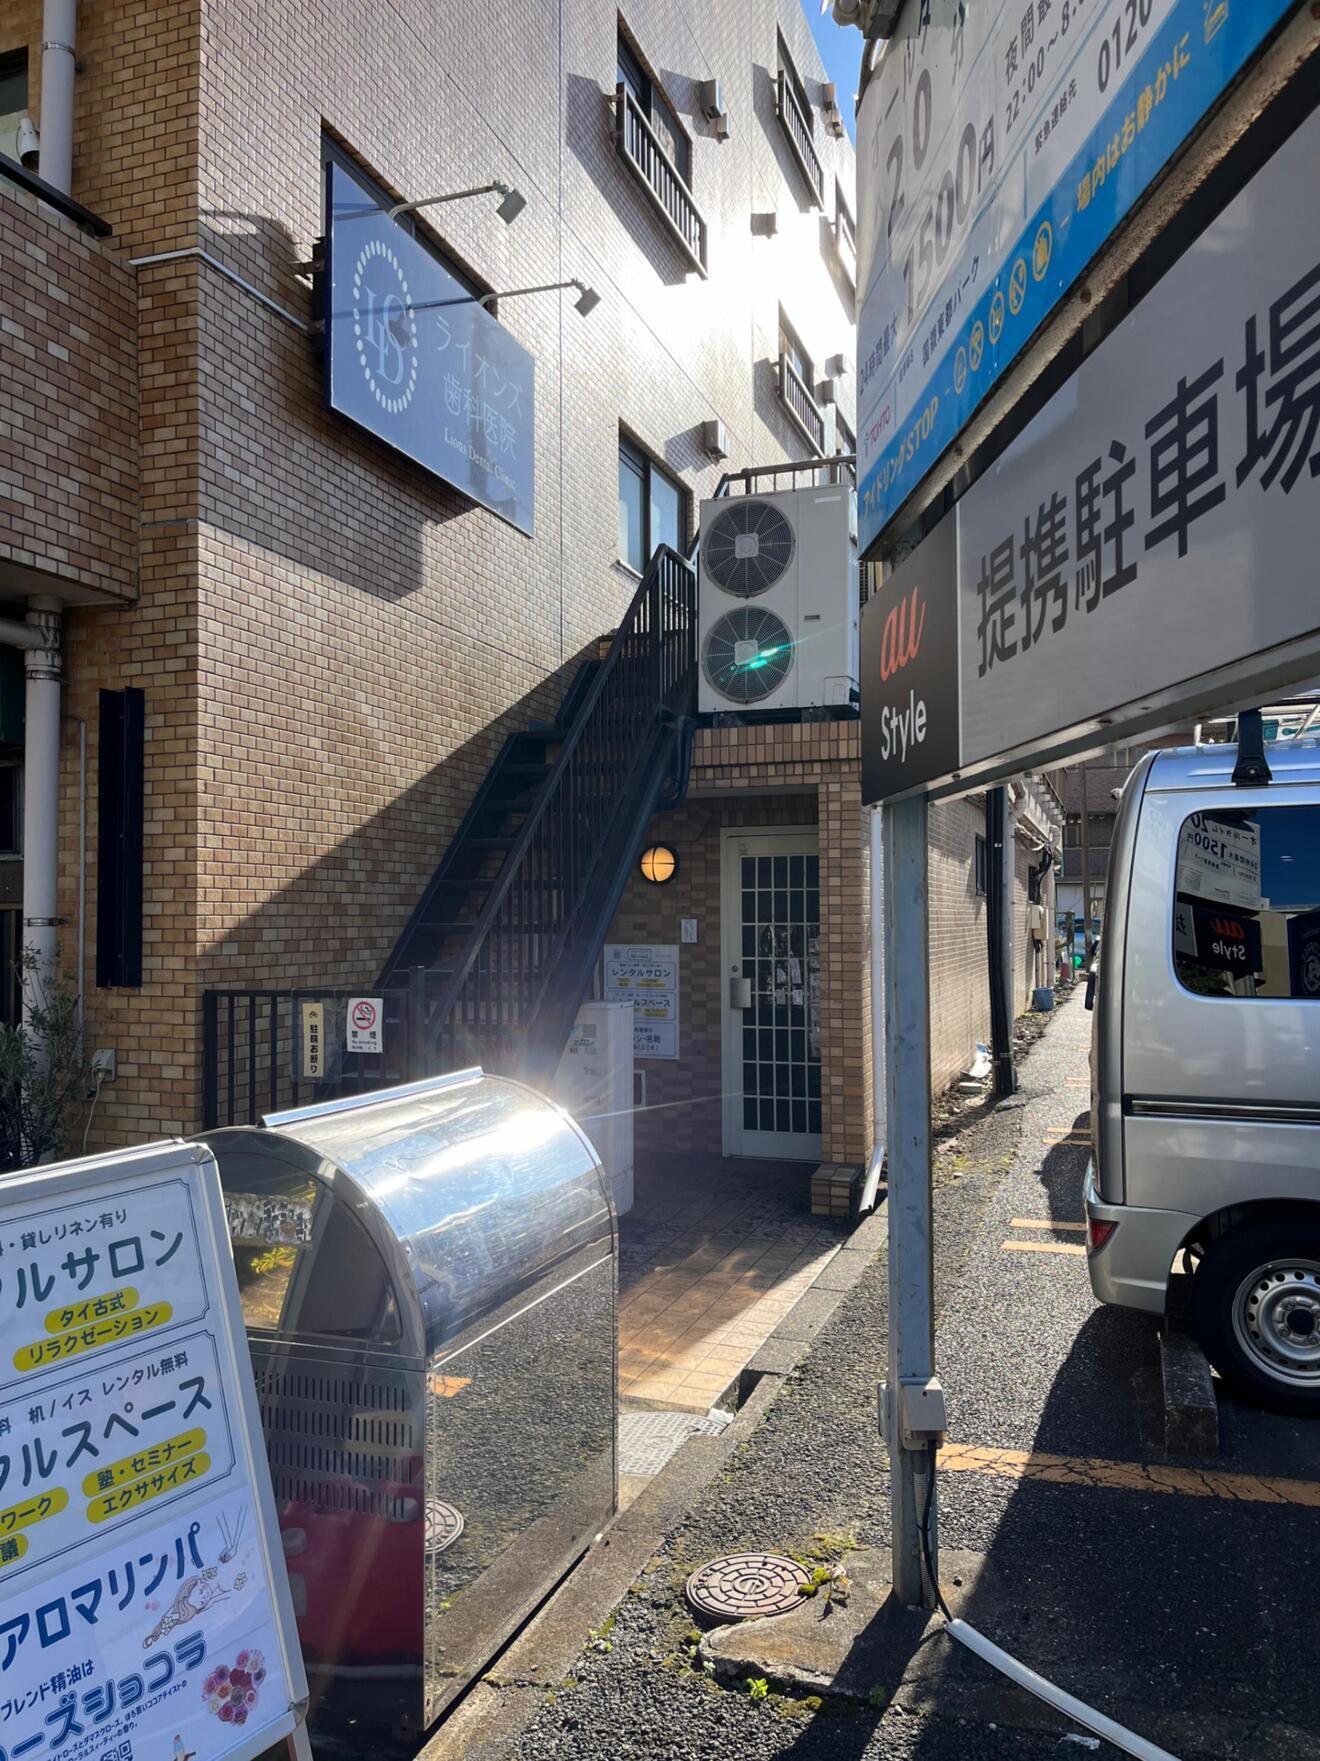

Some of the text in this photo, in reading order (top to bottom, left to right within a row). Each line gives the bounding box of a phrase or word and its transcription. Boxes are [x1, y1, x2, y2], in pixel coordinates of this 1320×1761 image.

[903, 114, 994, 325] 1500円
[436, 314, 523, 419] ライオンズ
[443, 371, 516, 460] 歯科医院
[444, 426, 516, 490] Lions Dental Clinic
[977, 266, 1320, 678] 提携駐車場
[879, 585, 927, 682] au
[880, 690, 927, 764] Style
[612, 968, 671, 978] レンタルサロン
[0, 1209, 127, 1257] ・貸しリネン有り
[0, 1230, 183, 1309] ルサロン
[28, 1309, 159, 1364] リラクゼーション
[60, 1292, 126, 1328] タイ古式
[102, 1351, 188, 1396] レンタル無料
[0, 1376, 212, 1492] ルスペース
[97, 1440, 193, 1492] 塾・セミナー
[1, 1496, 52, 1530] ワーク
[103, 1457, 197, 1515] エクササイズ
[0, 1521, 204, 1672] アロマリンパ
[0, 1629, 207, 1761] ーズショコラ
